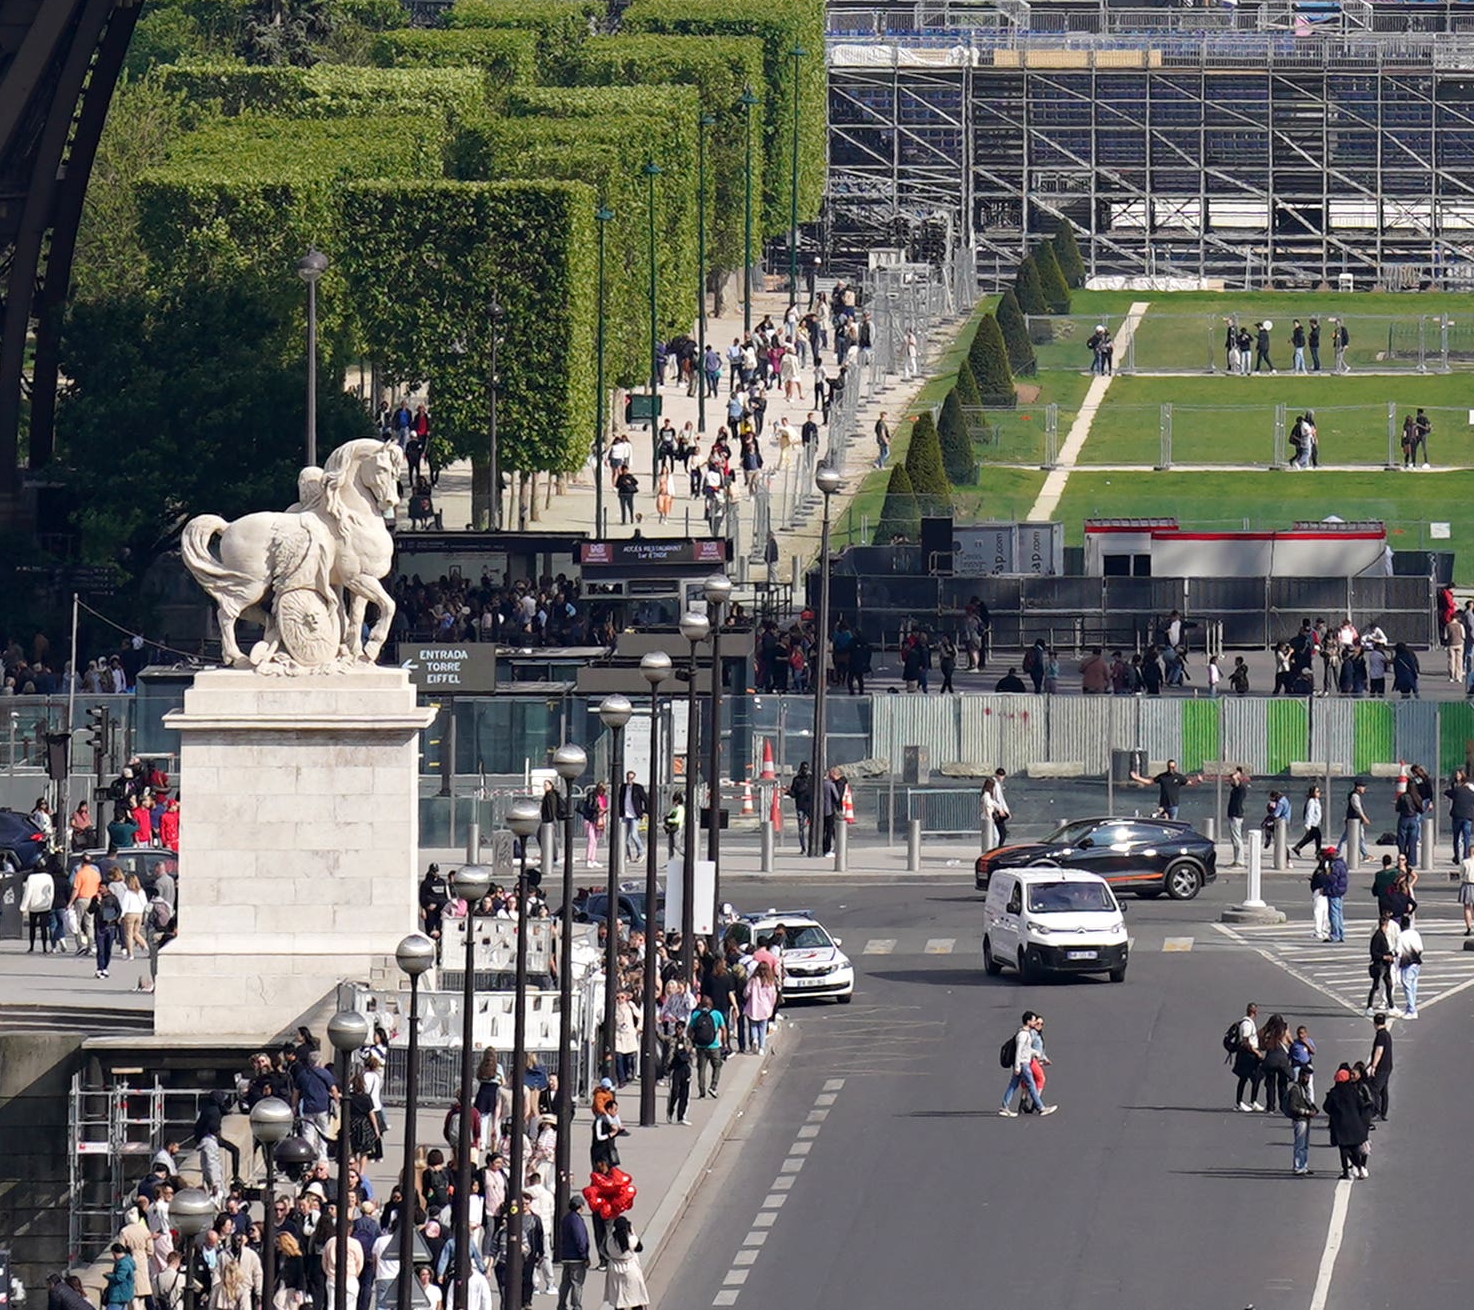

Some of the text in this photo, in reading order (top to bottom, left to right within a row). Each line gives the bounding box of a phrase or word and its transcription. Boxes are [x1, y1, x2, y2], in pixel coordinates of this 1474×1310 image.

[419, 650, 468, 660] ENTRADA
[426, 661, 461, 671] TORRE
[427, 673, 461, 684] EIFFEL
